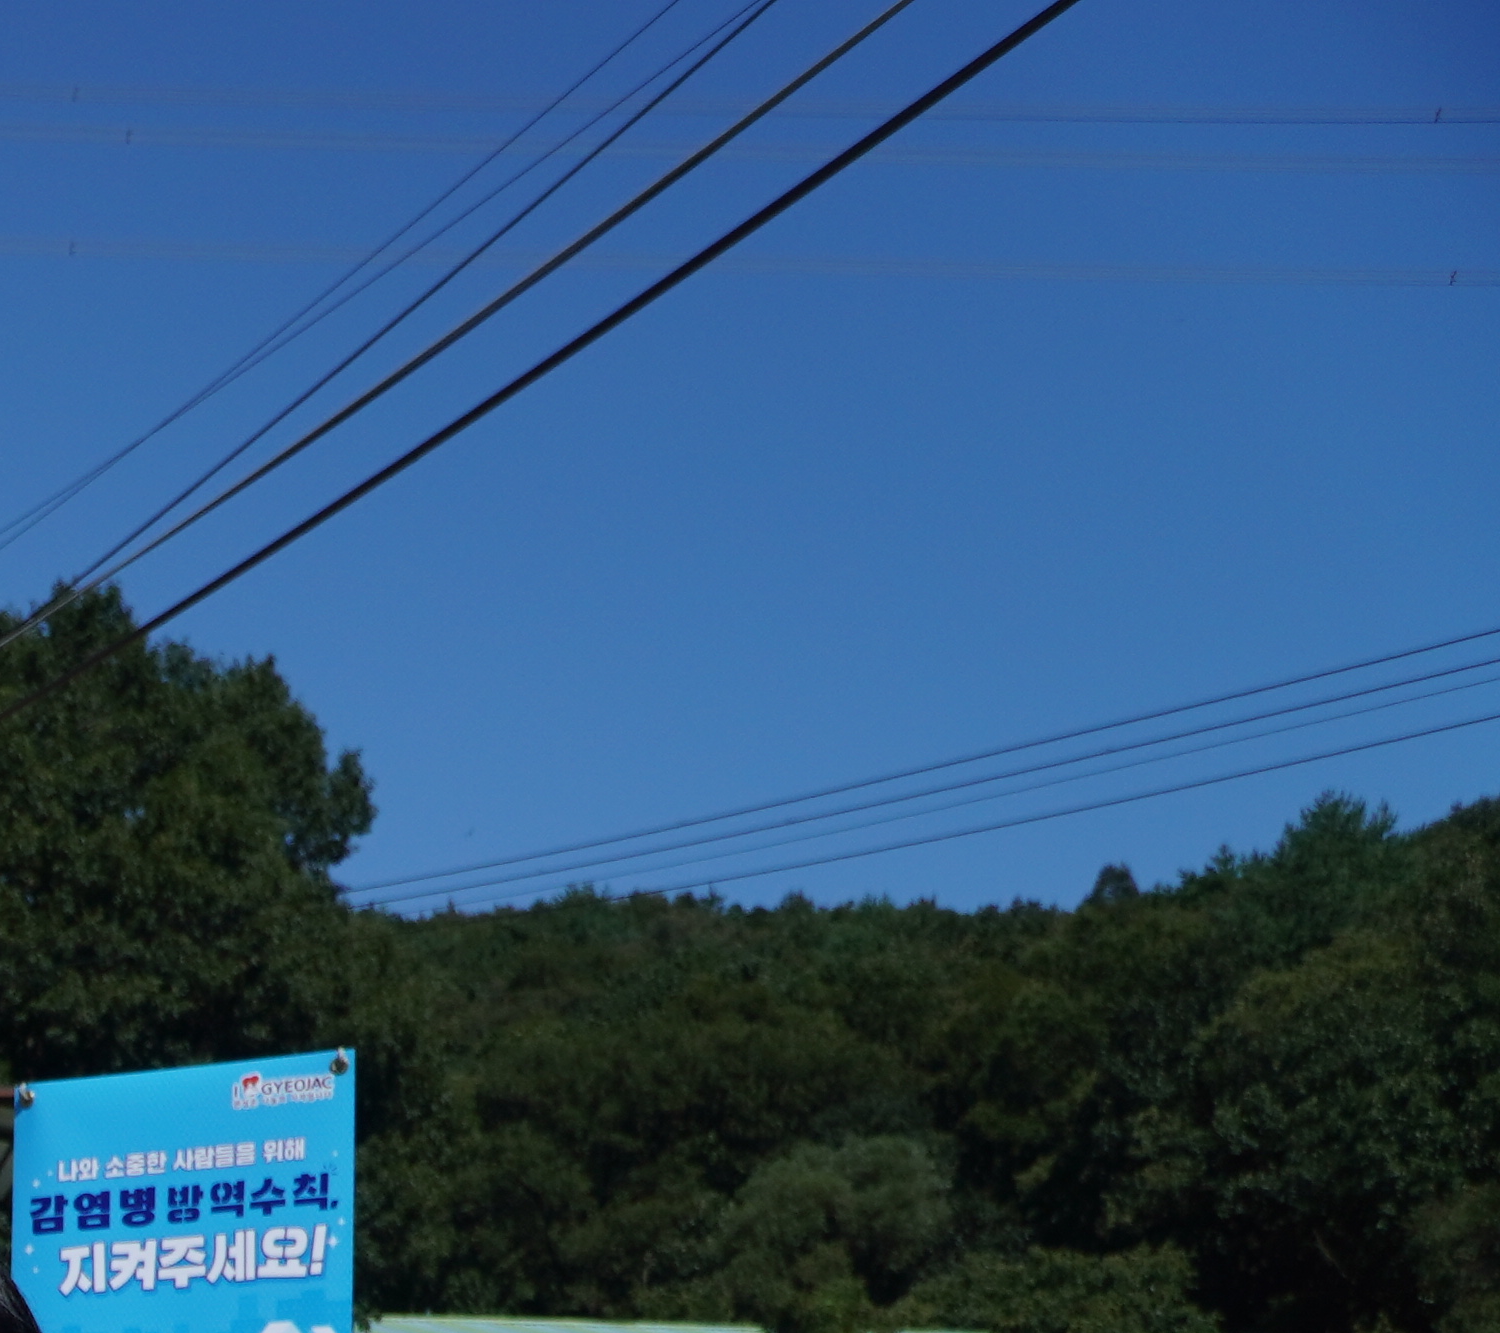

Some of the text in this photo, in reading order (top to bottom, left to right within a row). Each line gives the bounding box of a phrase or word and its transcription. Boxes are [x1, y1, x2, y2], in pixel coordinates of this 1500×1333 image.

[58, 1136, 305, 1182] 나와 소중한 사람들을 위해
[30, 1186, 156, 1236] 감염병
[58, 1223, 328, 1296] 지켜주세요!
